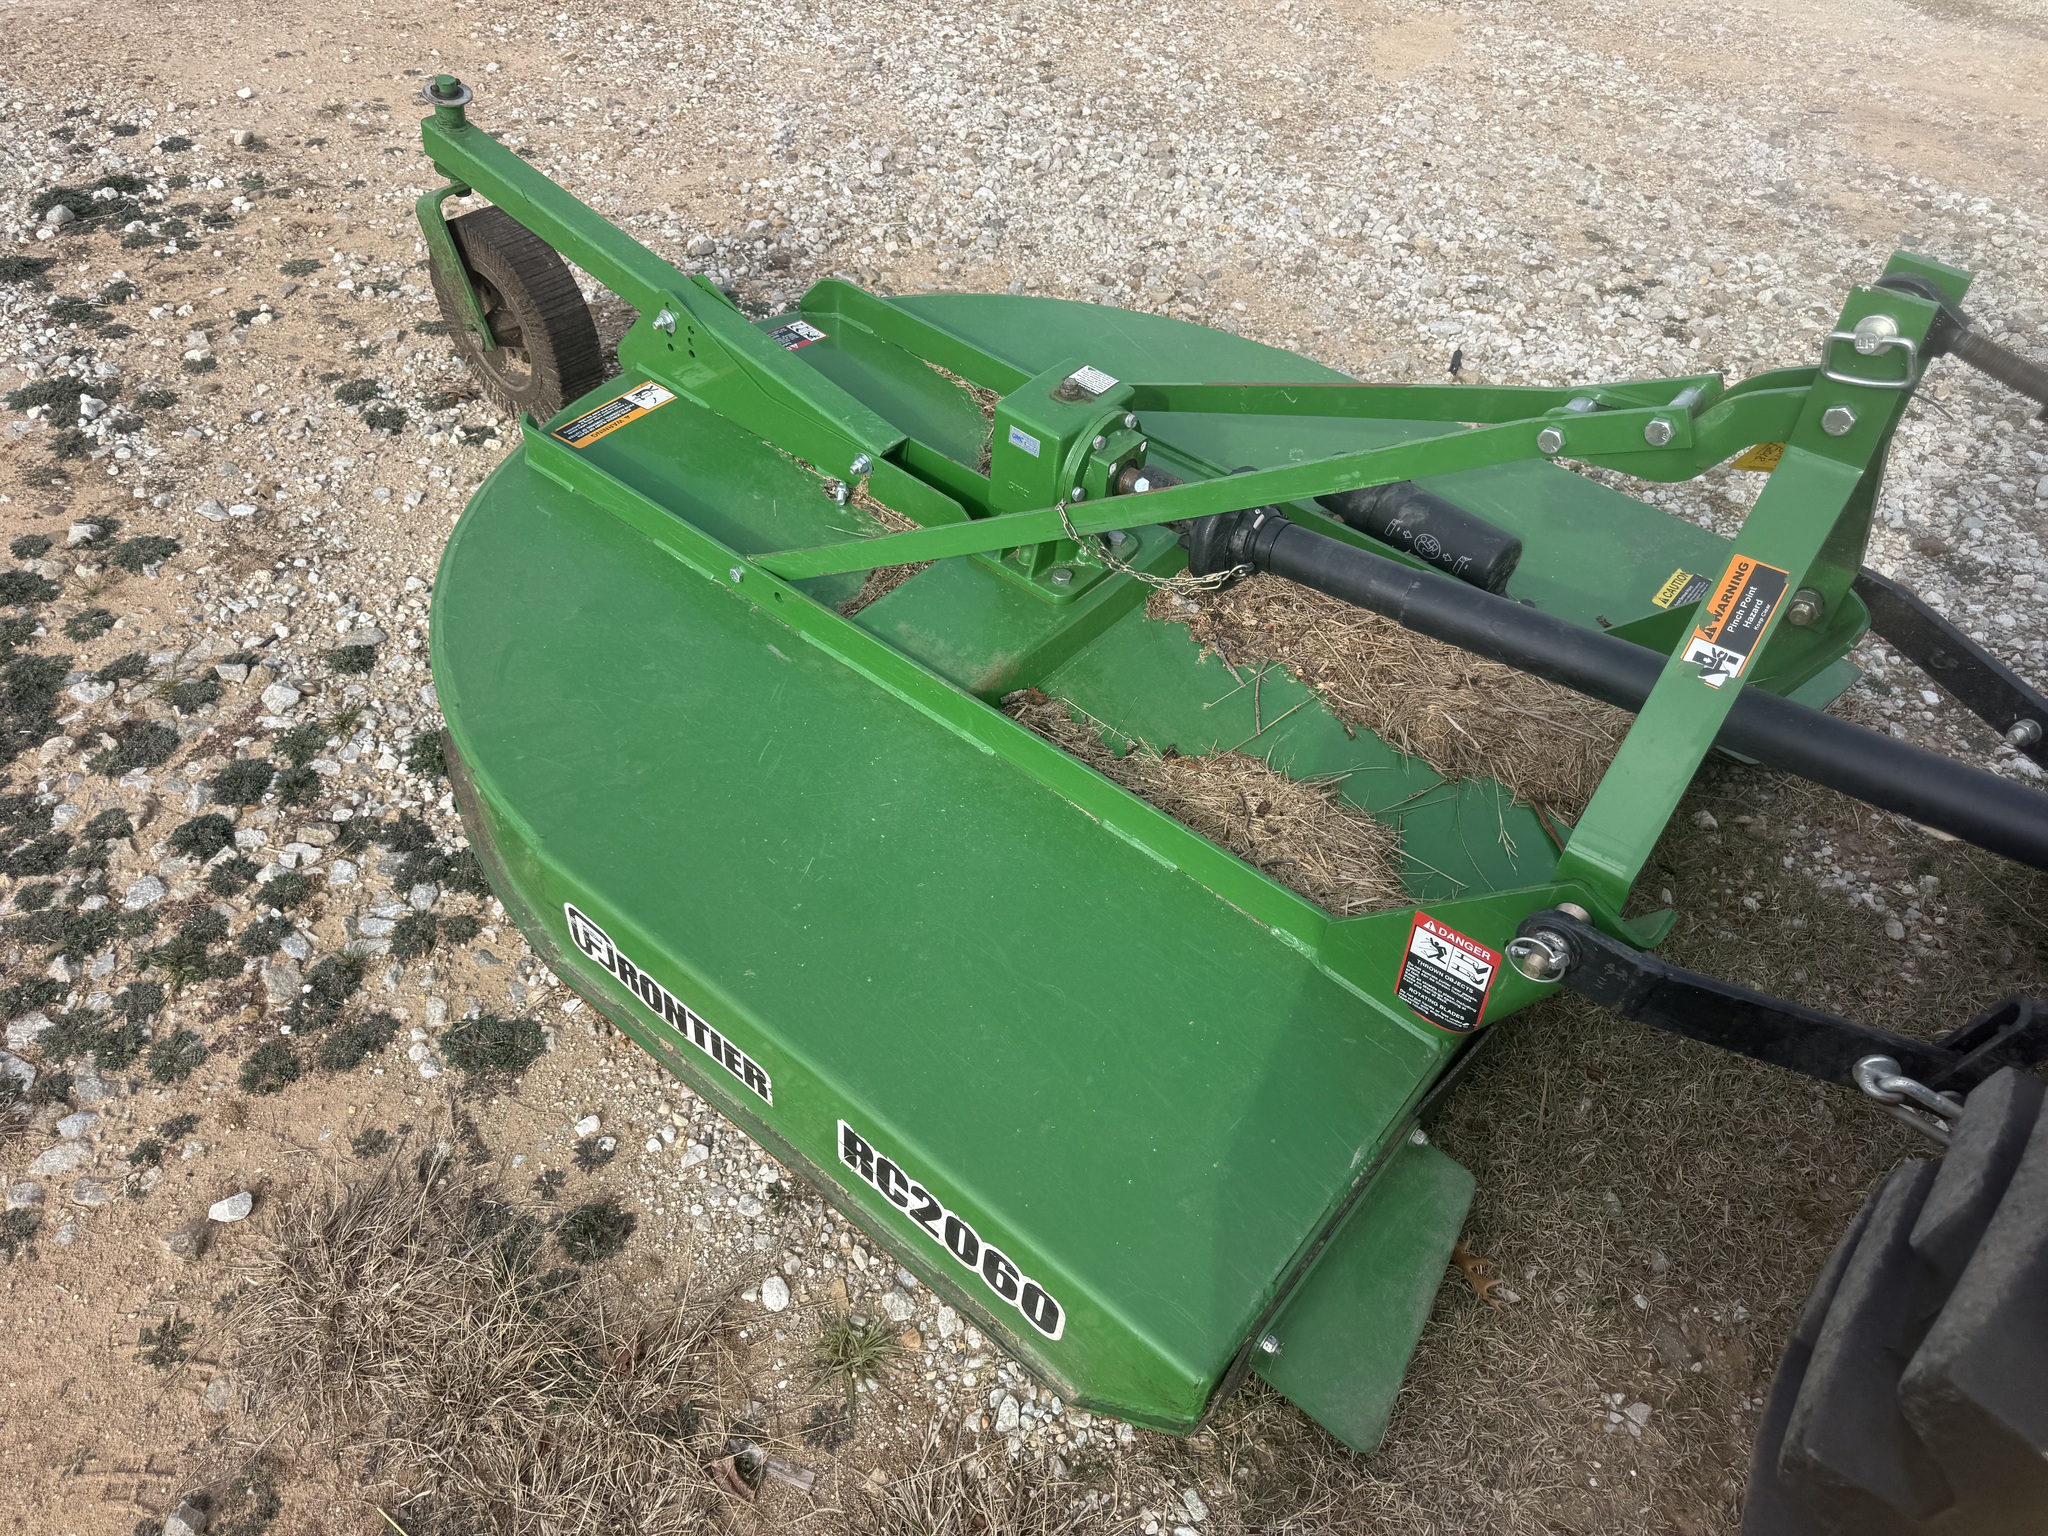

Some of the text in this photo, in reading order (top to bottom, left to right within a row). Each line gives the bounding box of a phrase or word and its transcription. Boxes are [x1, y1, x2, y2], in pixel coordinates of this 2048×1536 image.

[590, 420, 625, 438] WARNING
[1713, 562, 1749, 623] WARNING
[1727, 586, 1758, 633] Pinch Point
[1742, 599, 1764, 629] Hazard
[1753, 603, 1771, 631] Keep Clear
[1438, 926, 1491, 961] DANGER
[1416, 960, 1474, 993] THROWN OBJECTS
[567, 905, 773, 1103] FRONTIER
[1408, 987, 1464, 1021] ROTATING BLADES
[842, 1123, 1061, 1336] RC2060
